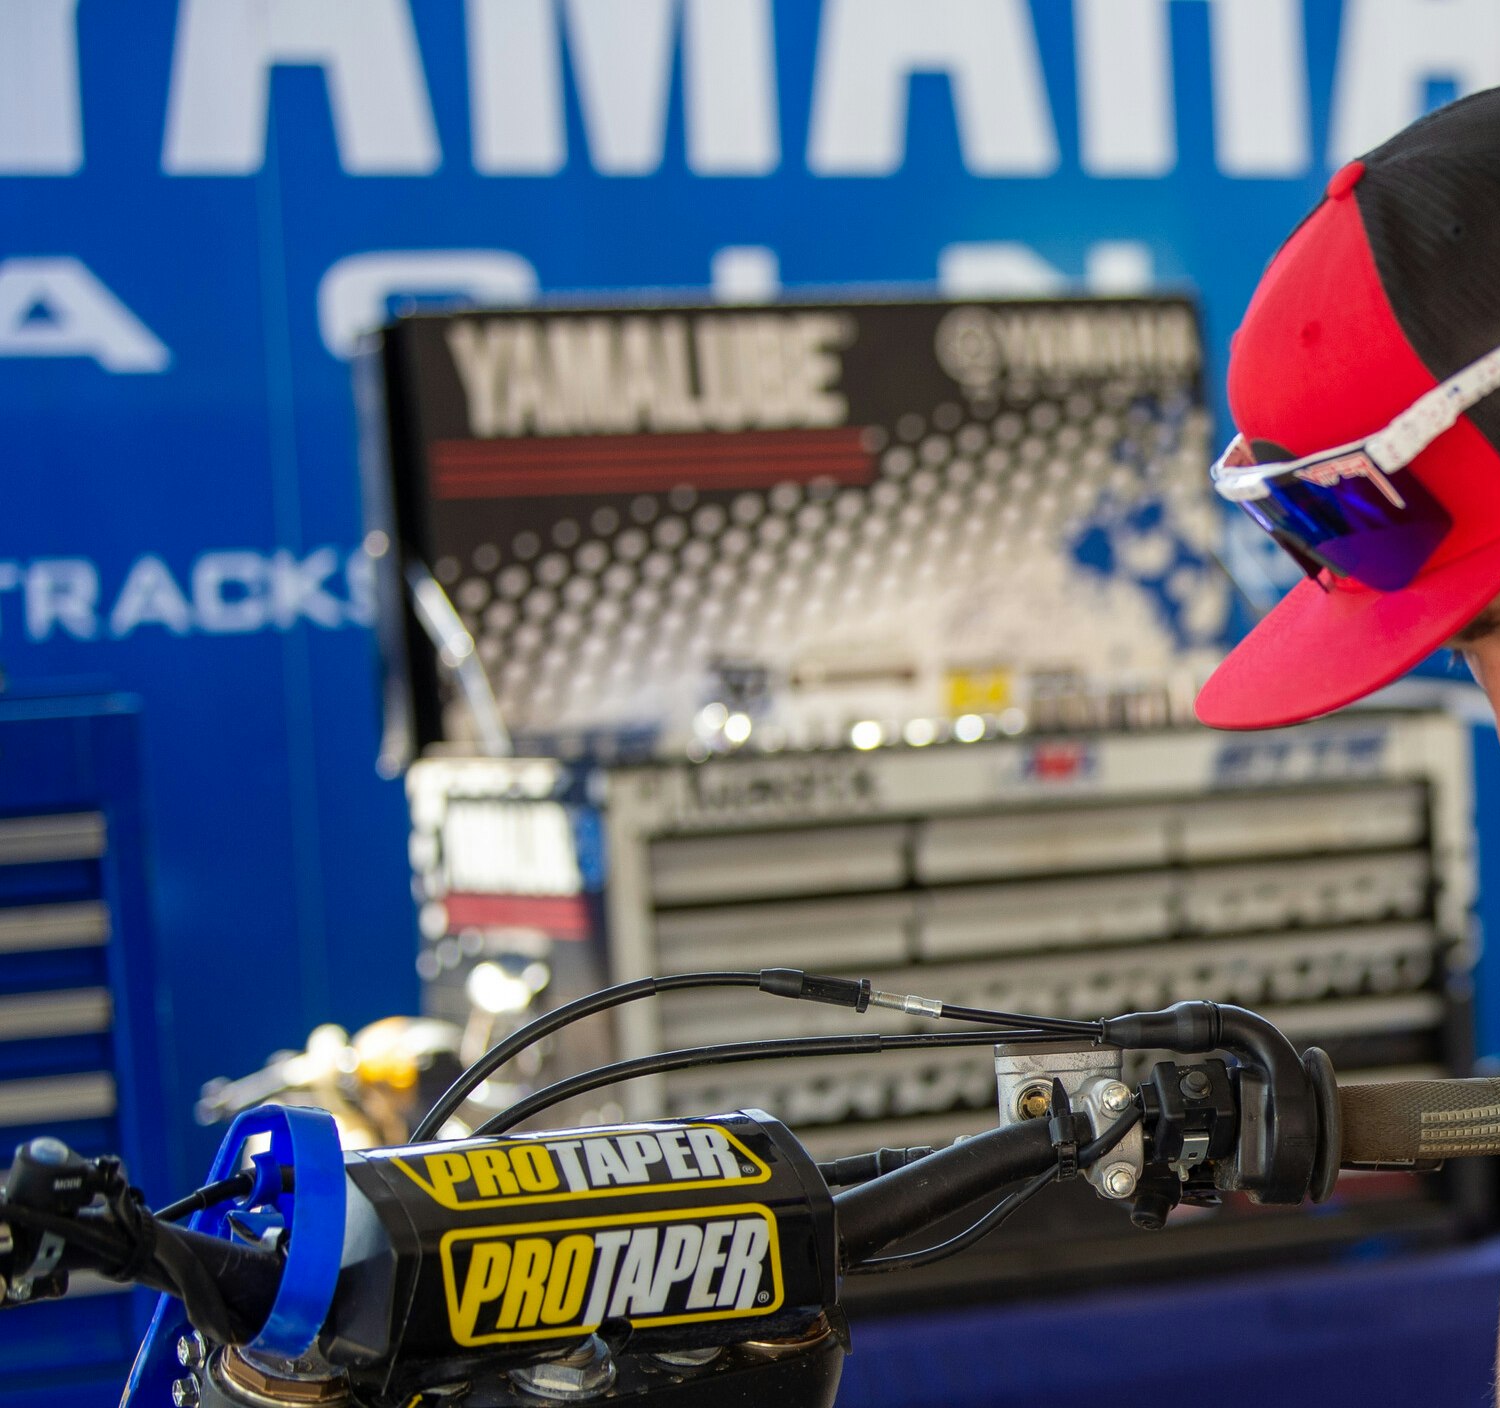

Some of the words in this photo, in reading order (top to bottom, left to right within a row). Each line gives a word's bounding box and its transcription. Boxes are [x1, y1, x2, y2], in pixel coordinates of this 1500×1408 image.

[446, 312, 854, 438] YAMALUBE
[0, 546, 378, 641] RACK
[424, 1128, 741, 1202] PROTAPER
[463, 1218, 770, 1336] PROTAPER
